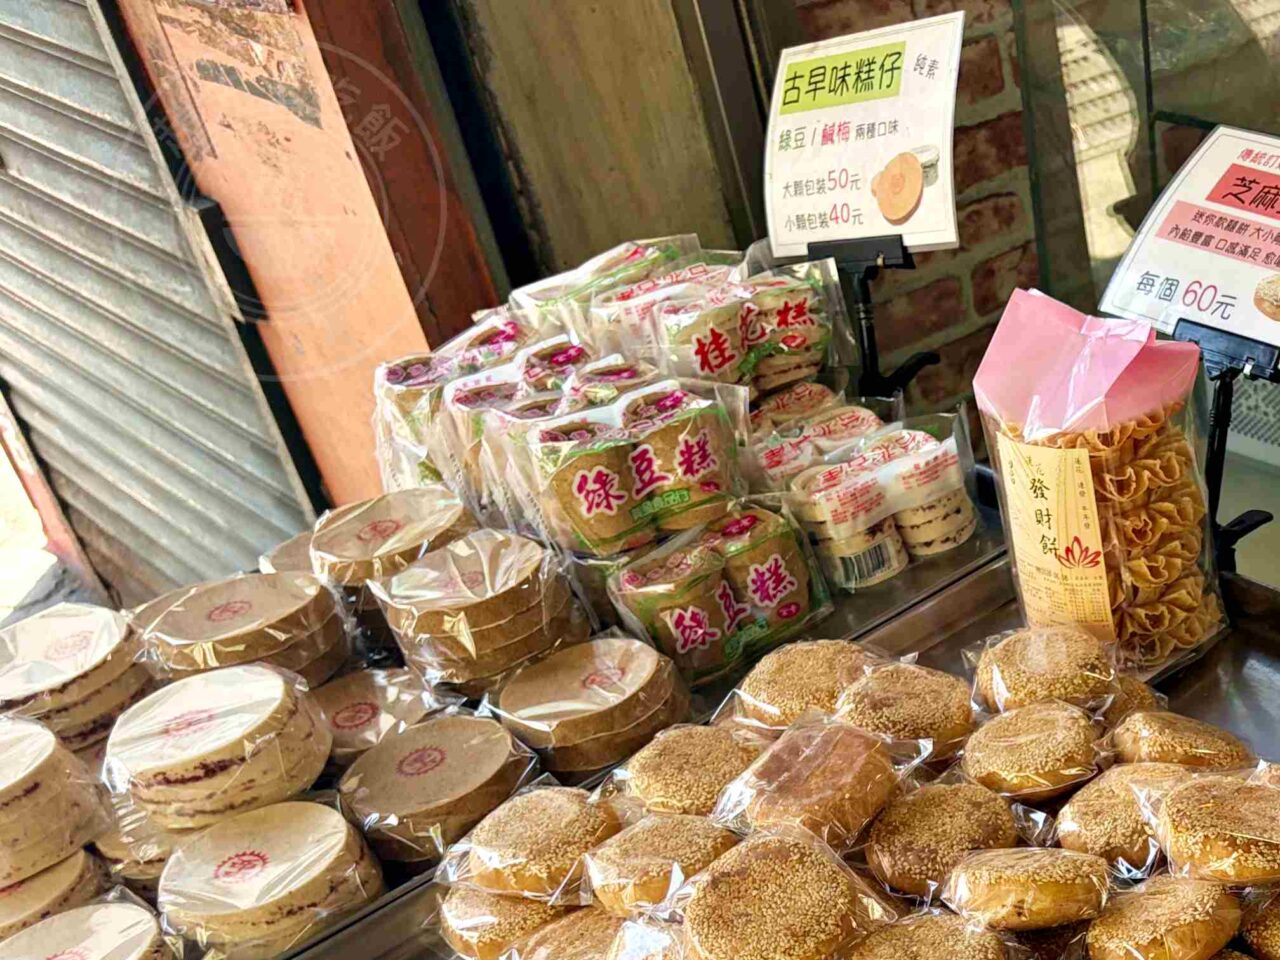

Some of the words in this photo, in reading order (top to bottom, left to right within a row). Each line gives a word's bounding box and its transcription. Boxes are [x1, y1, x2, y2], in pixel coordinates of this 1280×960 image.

[782, 51, 903, 106] 古早味糕仔
[778, 126, 807, 152] 綠豆
[855, 120, 899, 141] 兩種口味
[1215, 239, 1262, 261] 口感滿足
[576, 432, 717, 515] 綠豆糕
[1029, 478, 1060, 559] 發財餅
